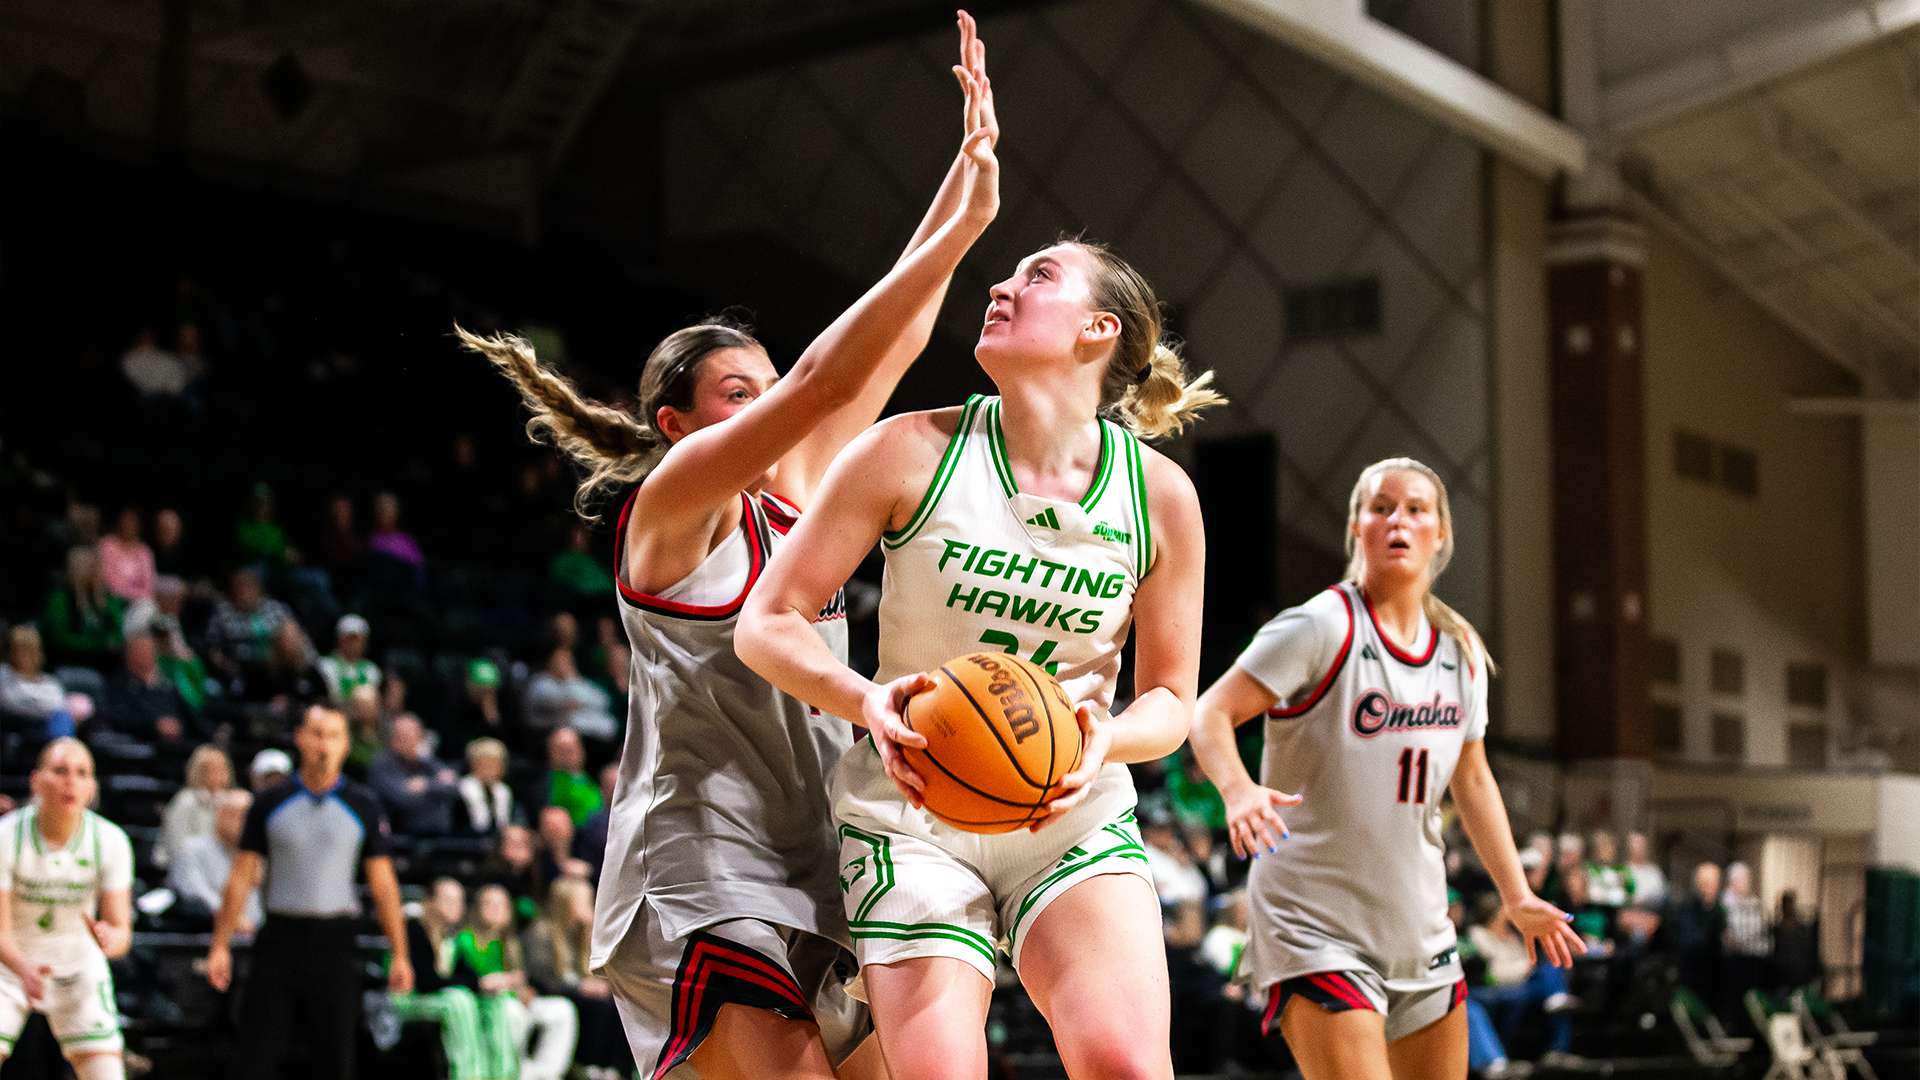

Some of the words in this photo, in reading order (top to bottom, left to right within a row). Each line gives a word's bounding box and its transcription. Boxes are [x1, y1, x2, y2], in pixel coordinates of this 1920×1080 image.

[1093, 524, 1132, 545] SUMMIT
[938, 538, 1125, 599] FIGHTING
[946, 583, 1104, 634] HAWKS
[967, 654, 1040, 744] Wilson
[1352, 689, 1463, 738] Omaha
[1397, 747, 1429, 804] 11
